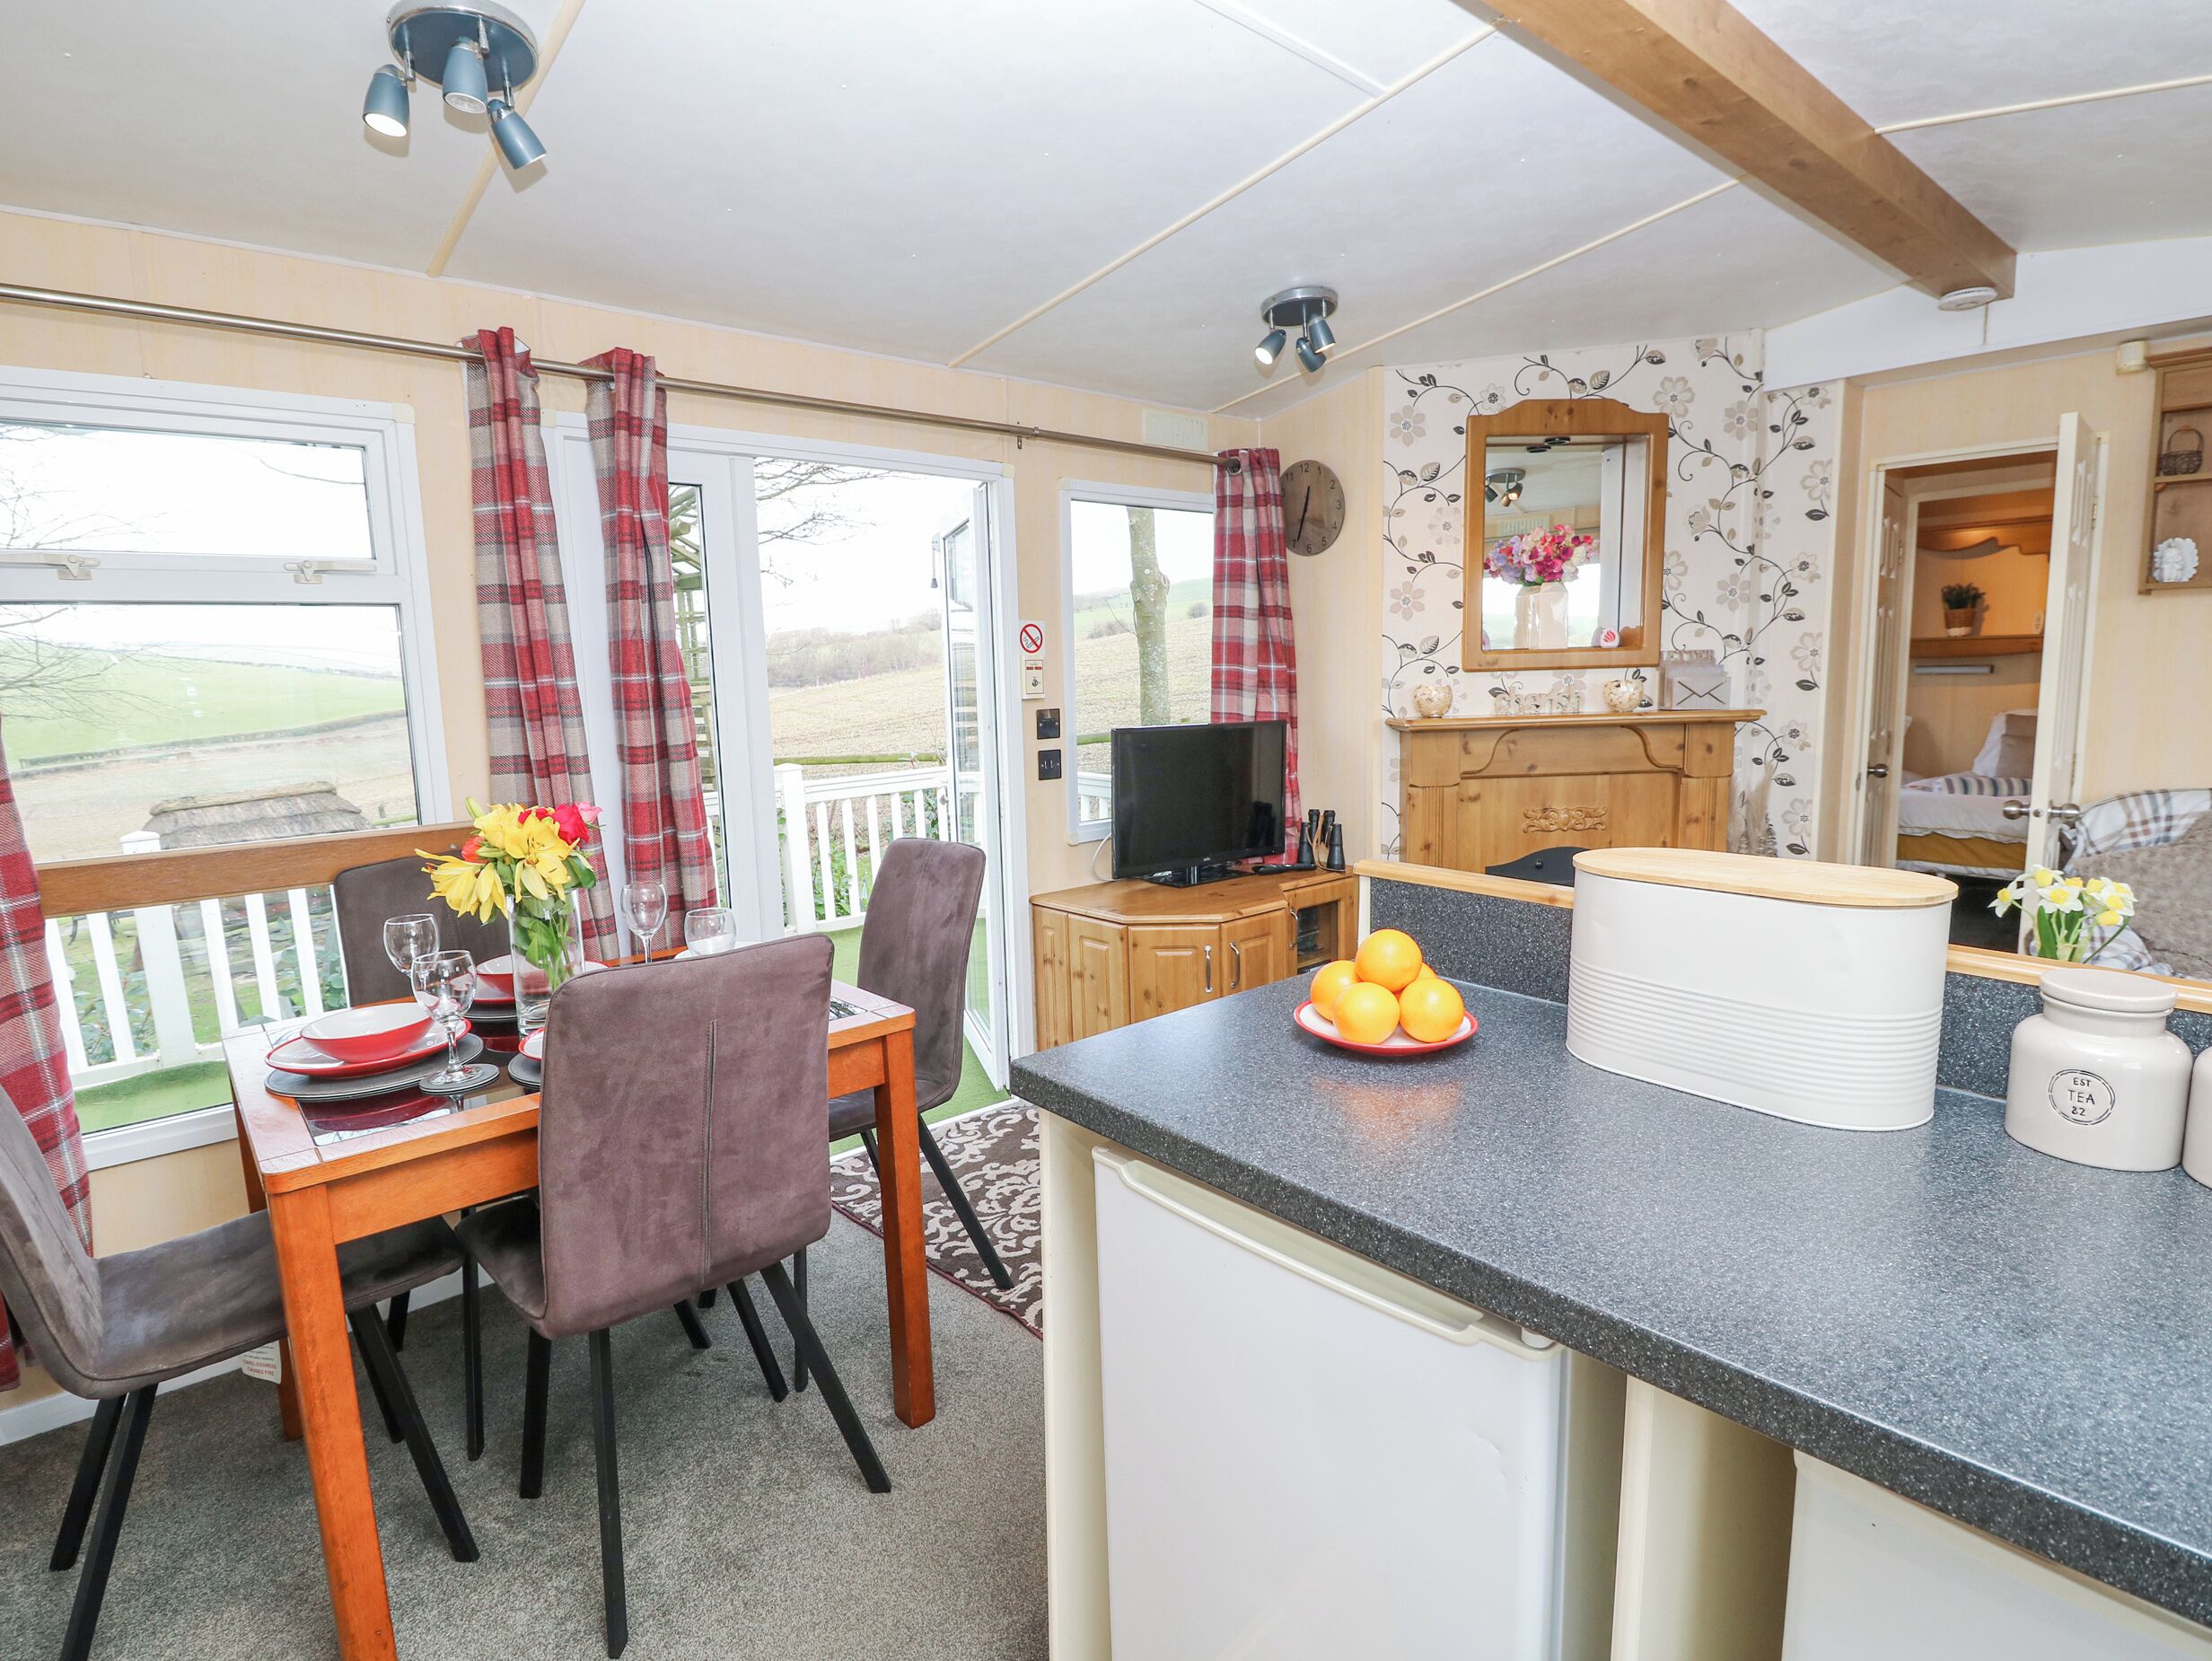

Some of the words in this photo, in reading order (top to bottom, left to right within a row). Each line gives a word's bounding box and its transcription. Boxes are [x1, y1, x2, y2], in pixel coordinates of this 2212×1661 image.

[1300, 463, 1309, 473] 12
[1286, 473, 1293, 481] 11
[1330, 479, 1335, 489] 2
[1337, 500, 1341, 510] 3
[1332, 521, 1338, 530] 4
[1321, 537, 1327, 546] 5
[1307, 543, 1312, 553] 6
[2073, 1077, 2091, 1086] EST
[2067, 1089, 2095, 1105] TEA
